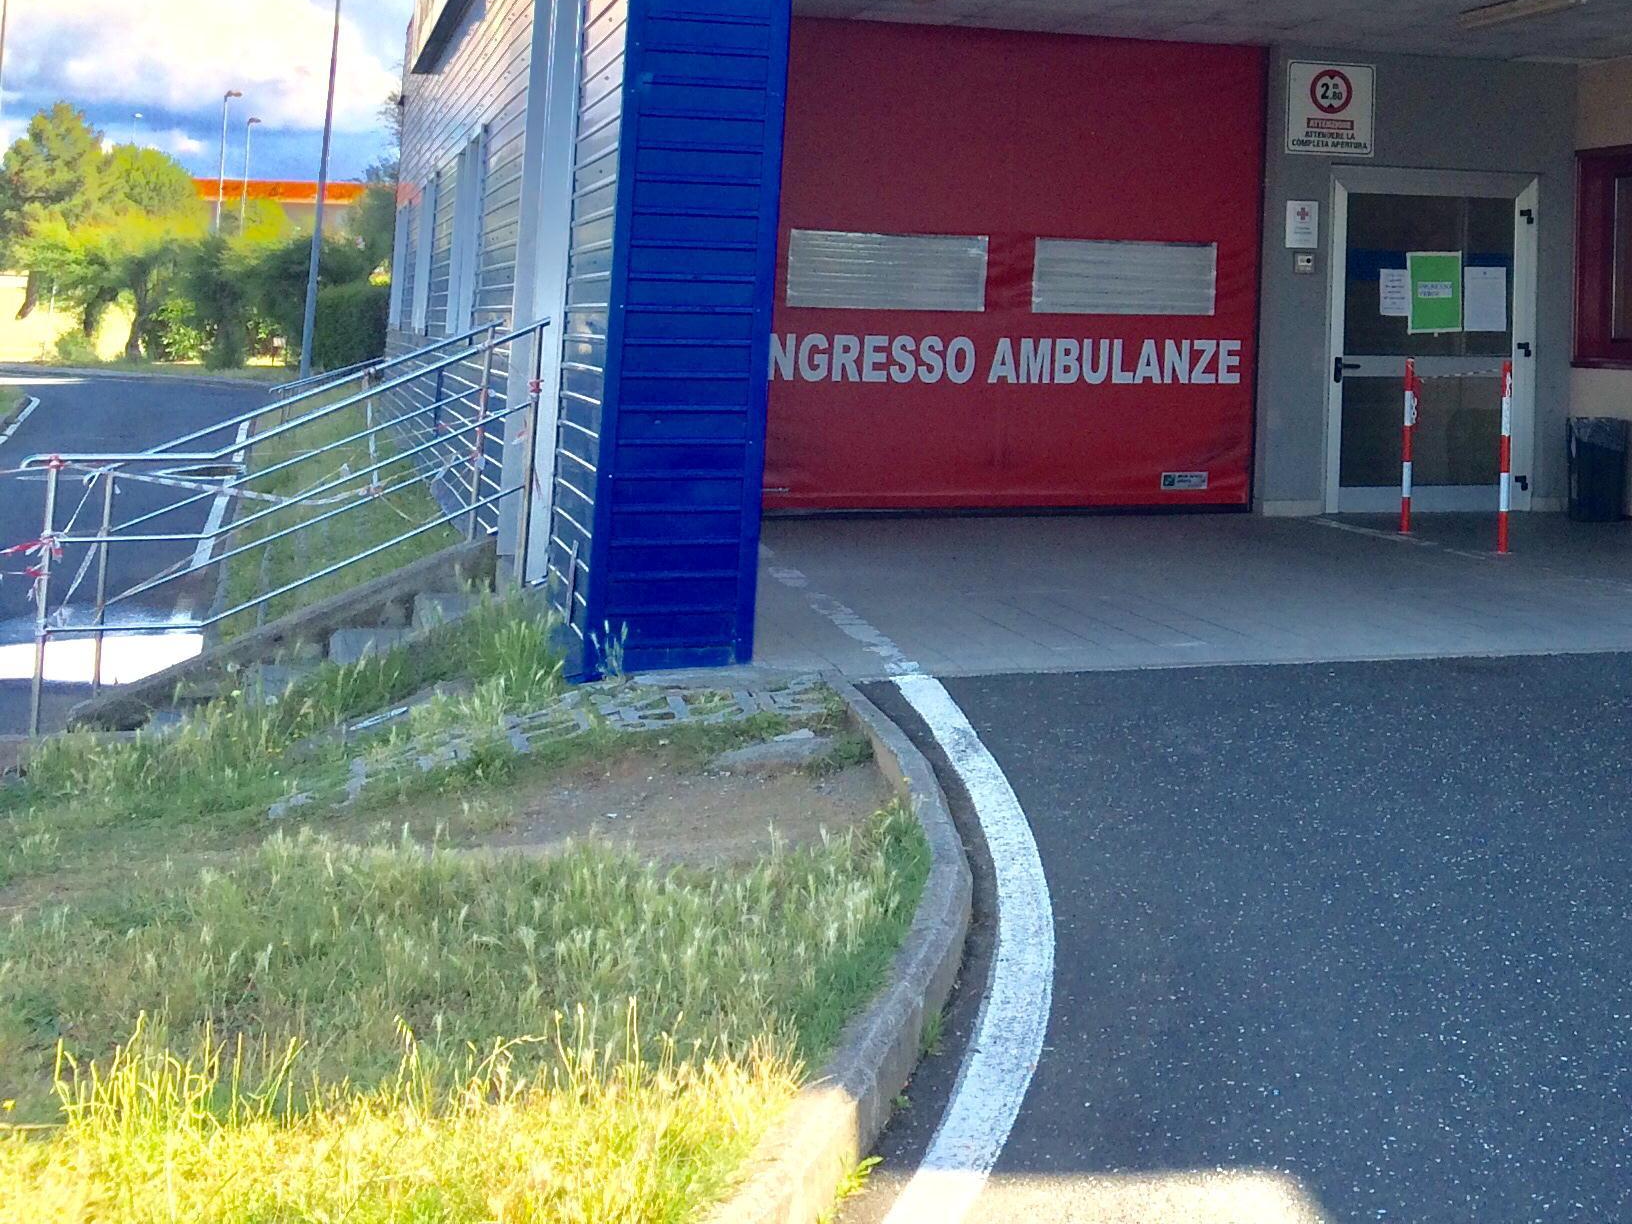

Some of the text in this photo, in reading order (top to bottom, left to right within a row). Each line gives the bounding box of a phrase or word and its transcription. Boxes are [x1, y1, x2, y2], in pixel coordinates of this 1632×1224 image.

[1305, 131, 1344, 139] ATTENDERE
[1291, 138, 1368, 149] COMPLETA APERTURA
[768, 333, 1241, 384] NGRESSO AMBULANZE
